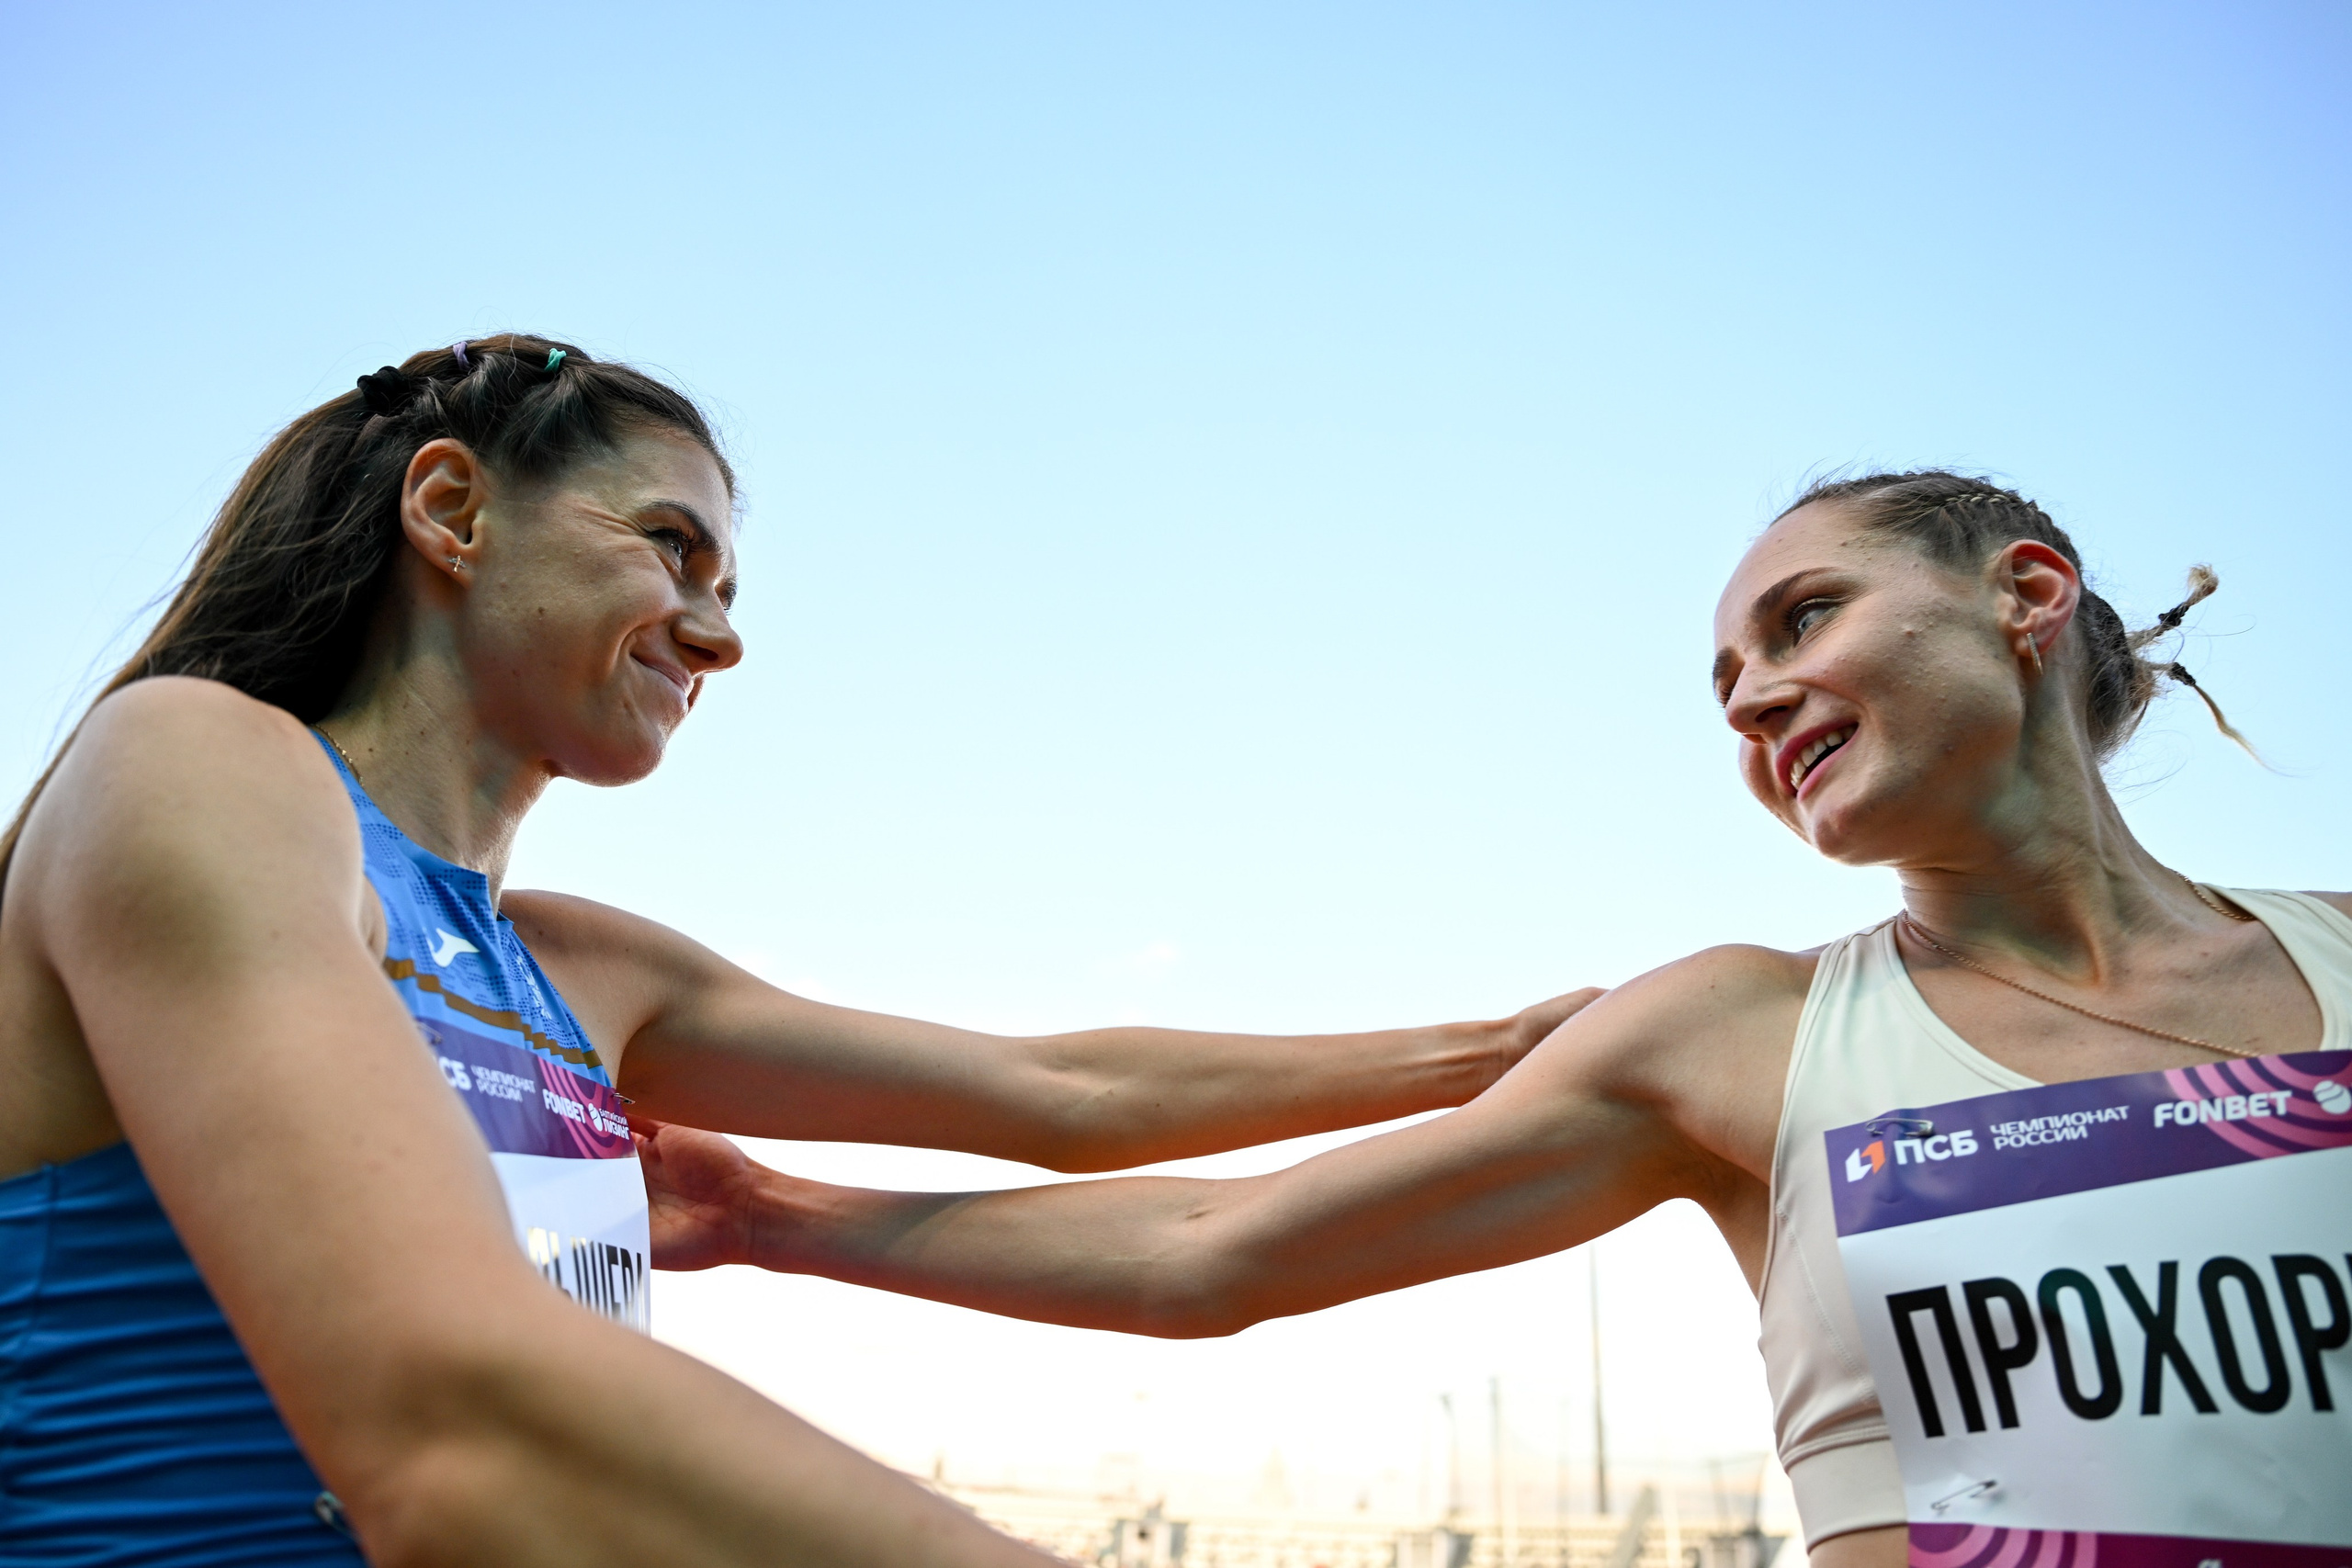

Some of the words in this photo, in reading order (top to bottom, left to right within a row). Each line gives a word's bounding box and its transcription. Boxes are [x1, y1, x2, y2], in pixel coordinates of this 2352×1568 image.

[438, 1057, 471, 1090] СБ
[470, 1064, 536, 1094] ЧЕМПИОНАТ
[476, 1078, 524, 1102] РОССИИ
[542, 1089, 586, 1124] FONBET
[1990, 1106, 2130, 1135] ЧЕМПИОНАТ
[2154, 1090, 2292, 1128] FONBET
[1894, 1130, 1979, 1165] ПСБ
[1995, 1125, 2088, 1150] РОССИИ
[1885, 1251, 2352, 1438] ПРОХОР
